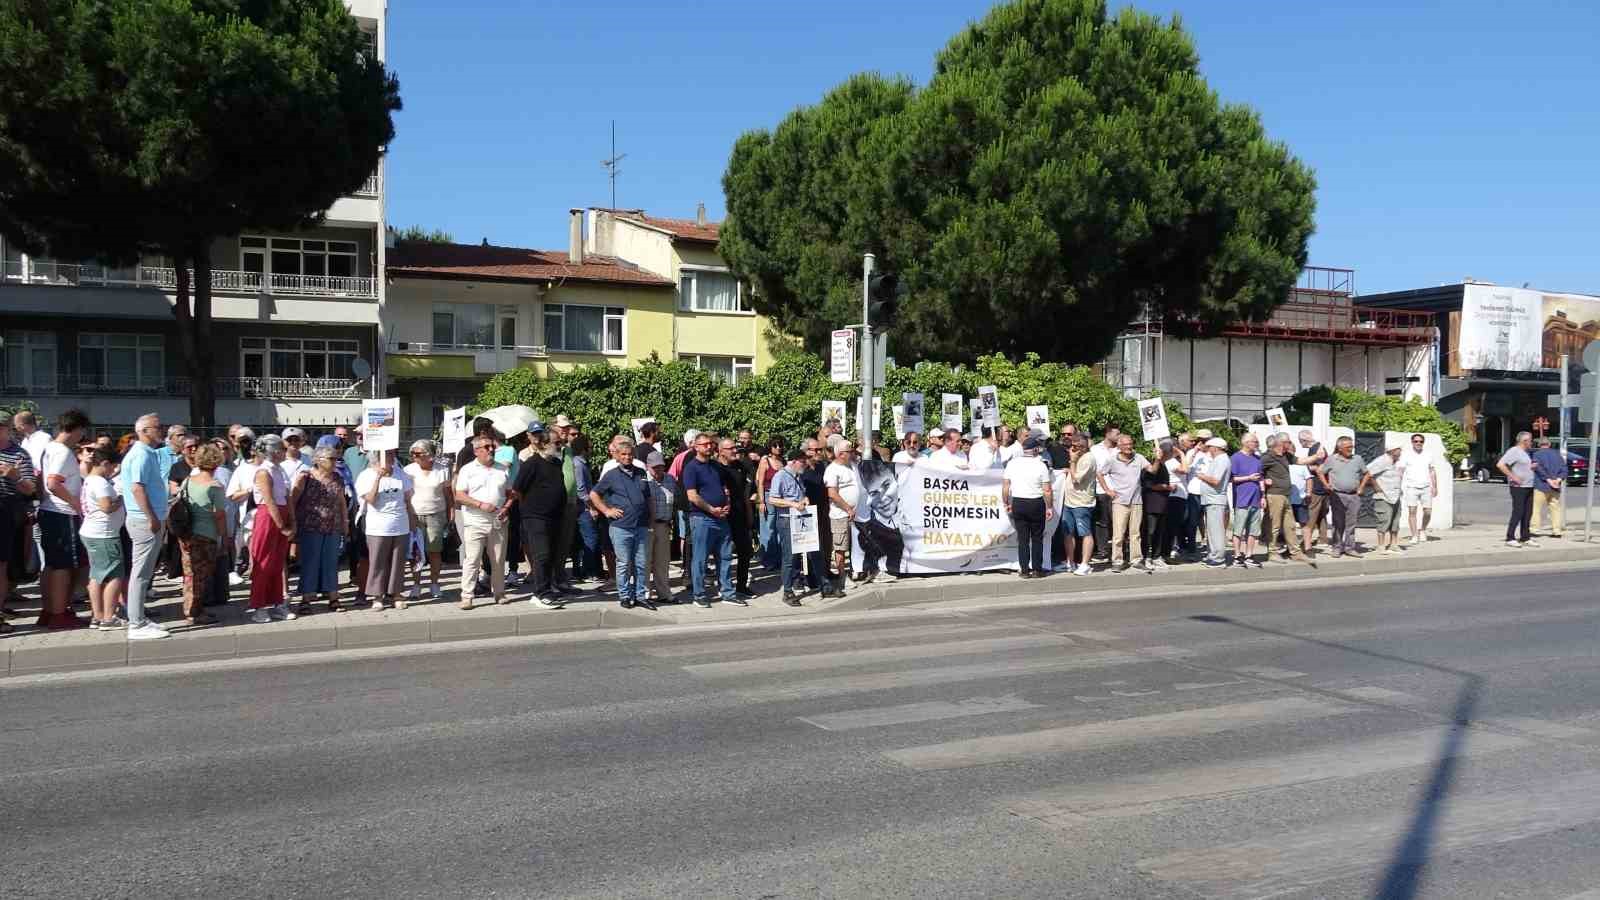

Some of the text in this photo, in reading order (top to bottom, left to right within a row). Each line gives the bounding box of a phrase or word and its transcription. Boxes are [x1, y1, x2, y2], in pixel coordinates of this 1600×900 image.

[923, 477, 969, 492] BAŞKA
[923, 504, 1000, 519] SÖNMESİN
[923, 518, 949, 529] DİYE
[923, 531, 983, 546] HAYATA
